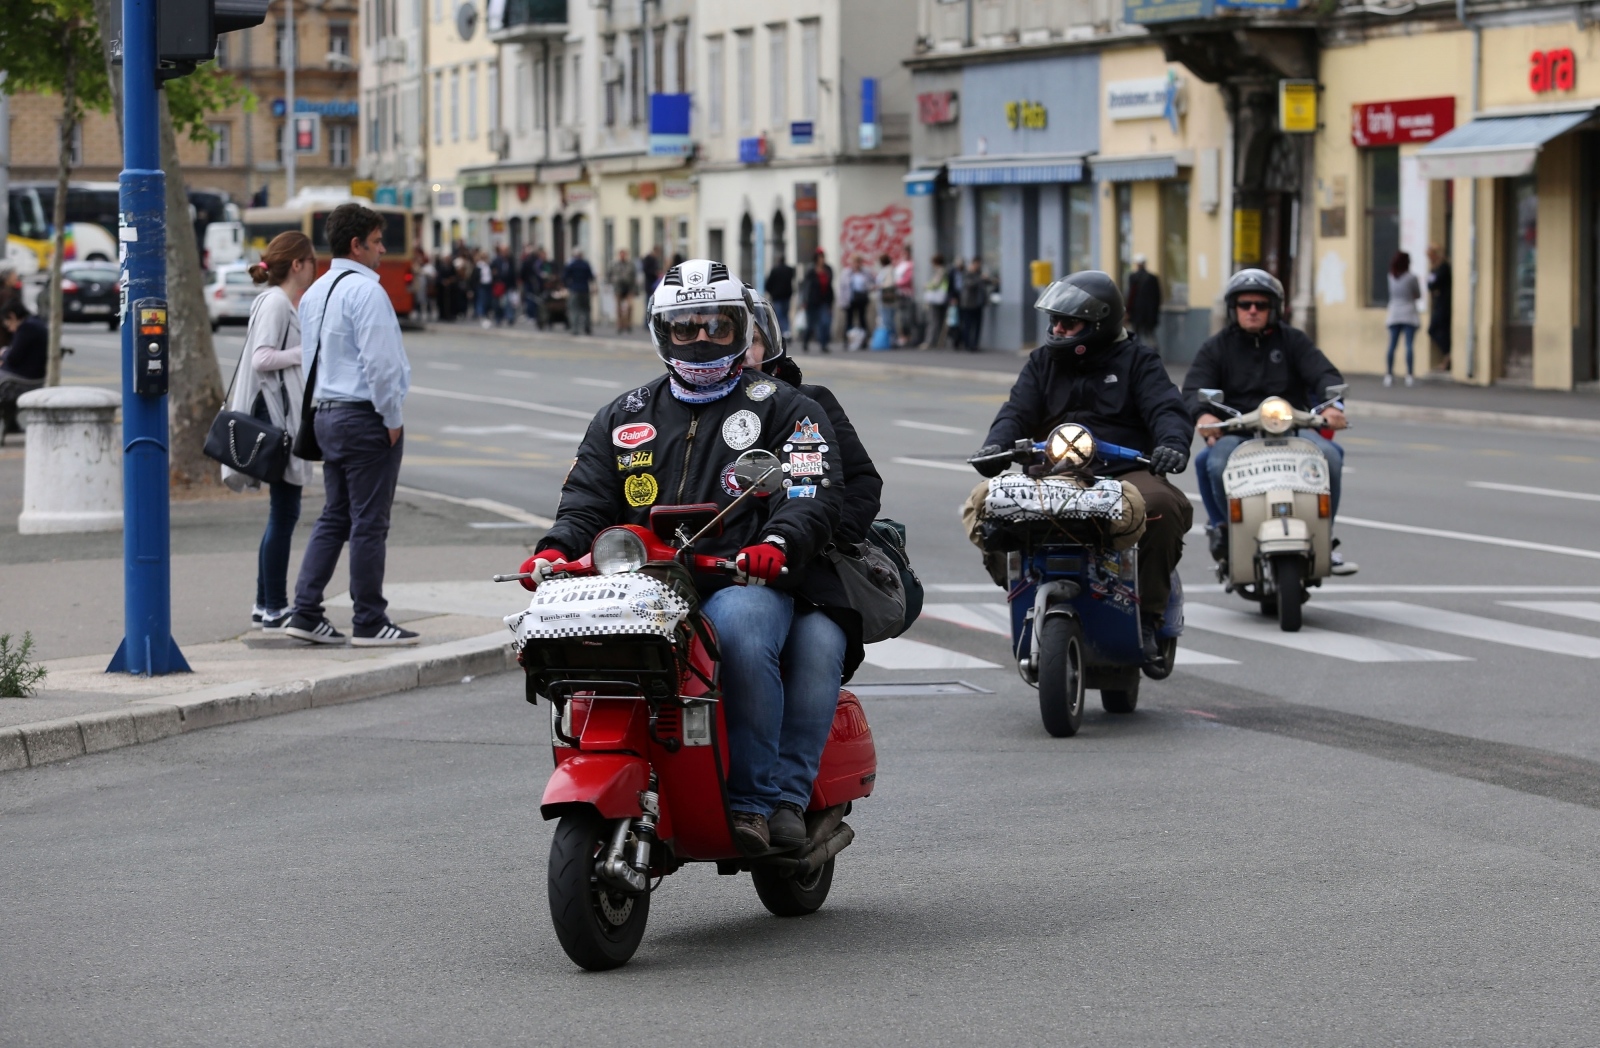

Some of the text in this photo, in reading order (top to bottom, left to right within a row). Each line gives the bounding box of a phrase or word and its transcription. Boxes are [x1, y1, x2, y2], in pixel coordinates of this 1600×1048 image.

[1529, 47, 1575, 93] ara
[687, 291, 715, 300] PLASTIC
[620, 428, 650, 441] Balordi
[1237, 464, 1296, 479] BALORDI
[537, 588, 628, 605] ALORDI
